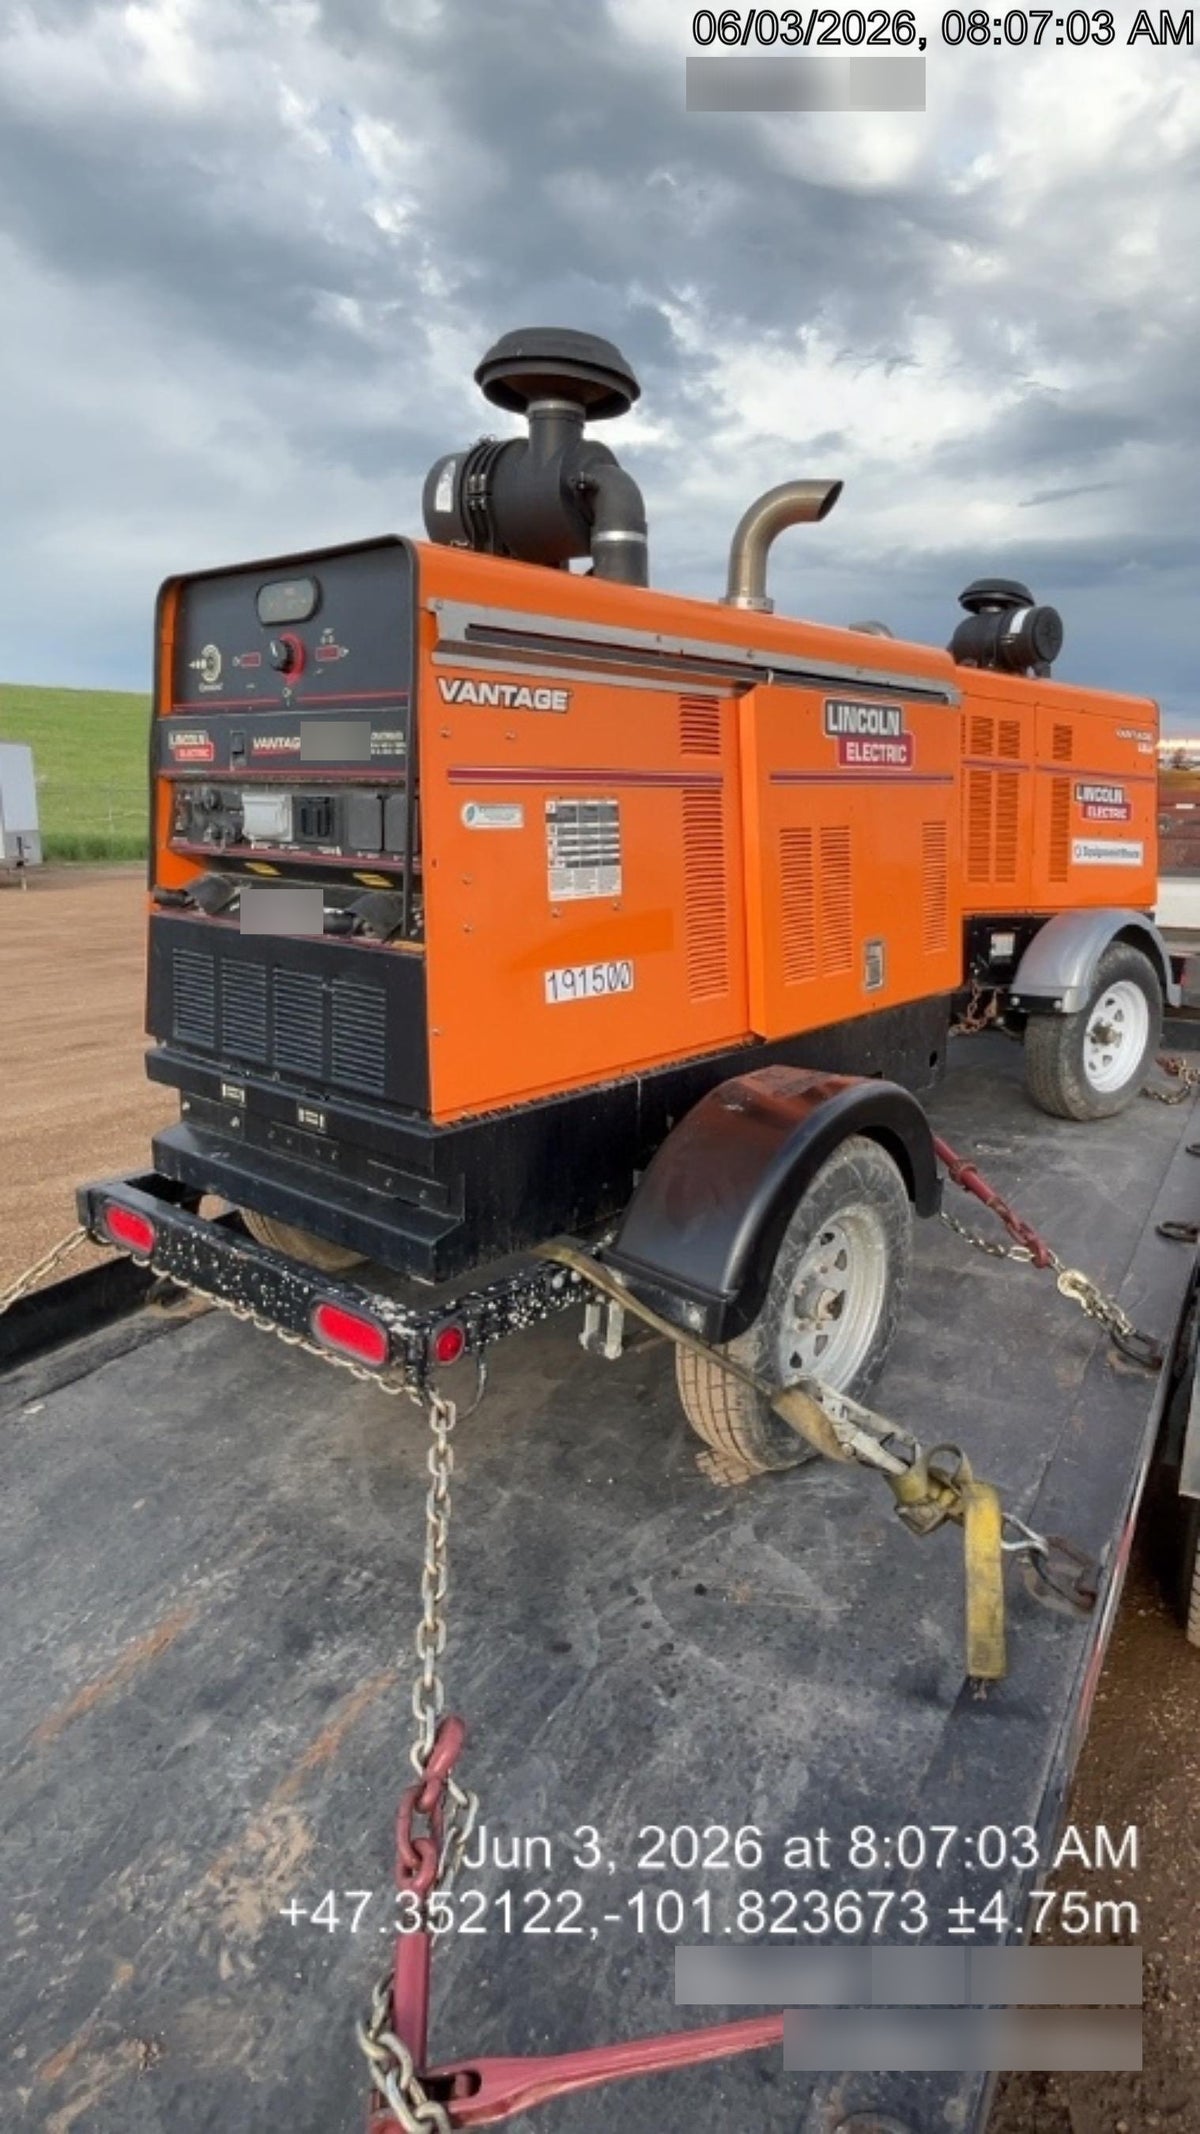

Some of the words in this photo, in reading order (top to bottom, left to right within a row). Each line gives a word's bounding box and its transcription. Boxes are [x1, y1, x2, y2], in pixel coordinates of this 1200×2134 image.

[438, 677, 568, 712] VANTAGE
[827, 703, 900, 735] LINCOLN
[253, 736, 301, 750] VANTAG
[846, 741, 907, 763] ELECTRIC
[1076, 786, 1123, 804] LINCOLN
[1087, 805, 1128, 819] ELECTRIC
[547, 962, 632, 1001] 191500
